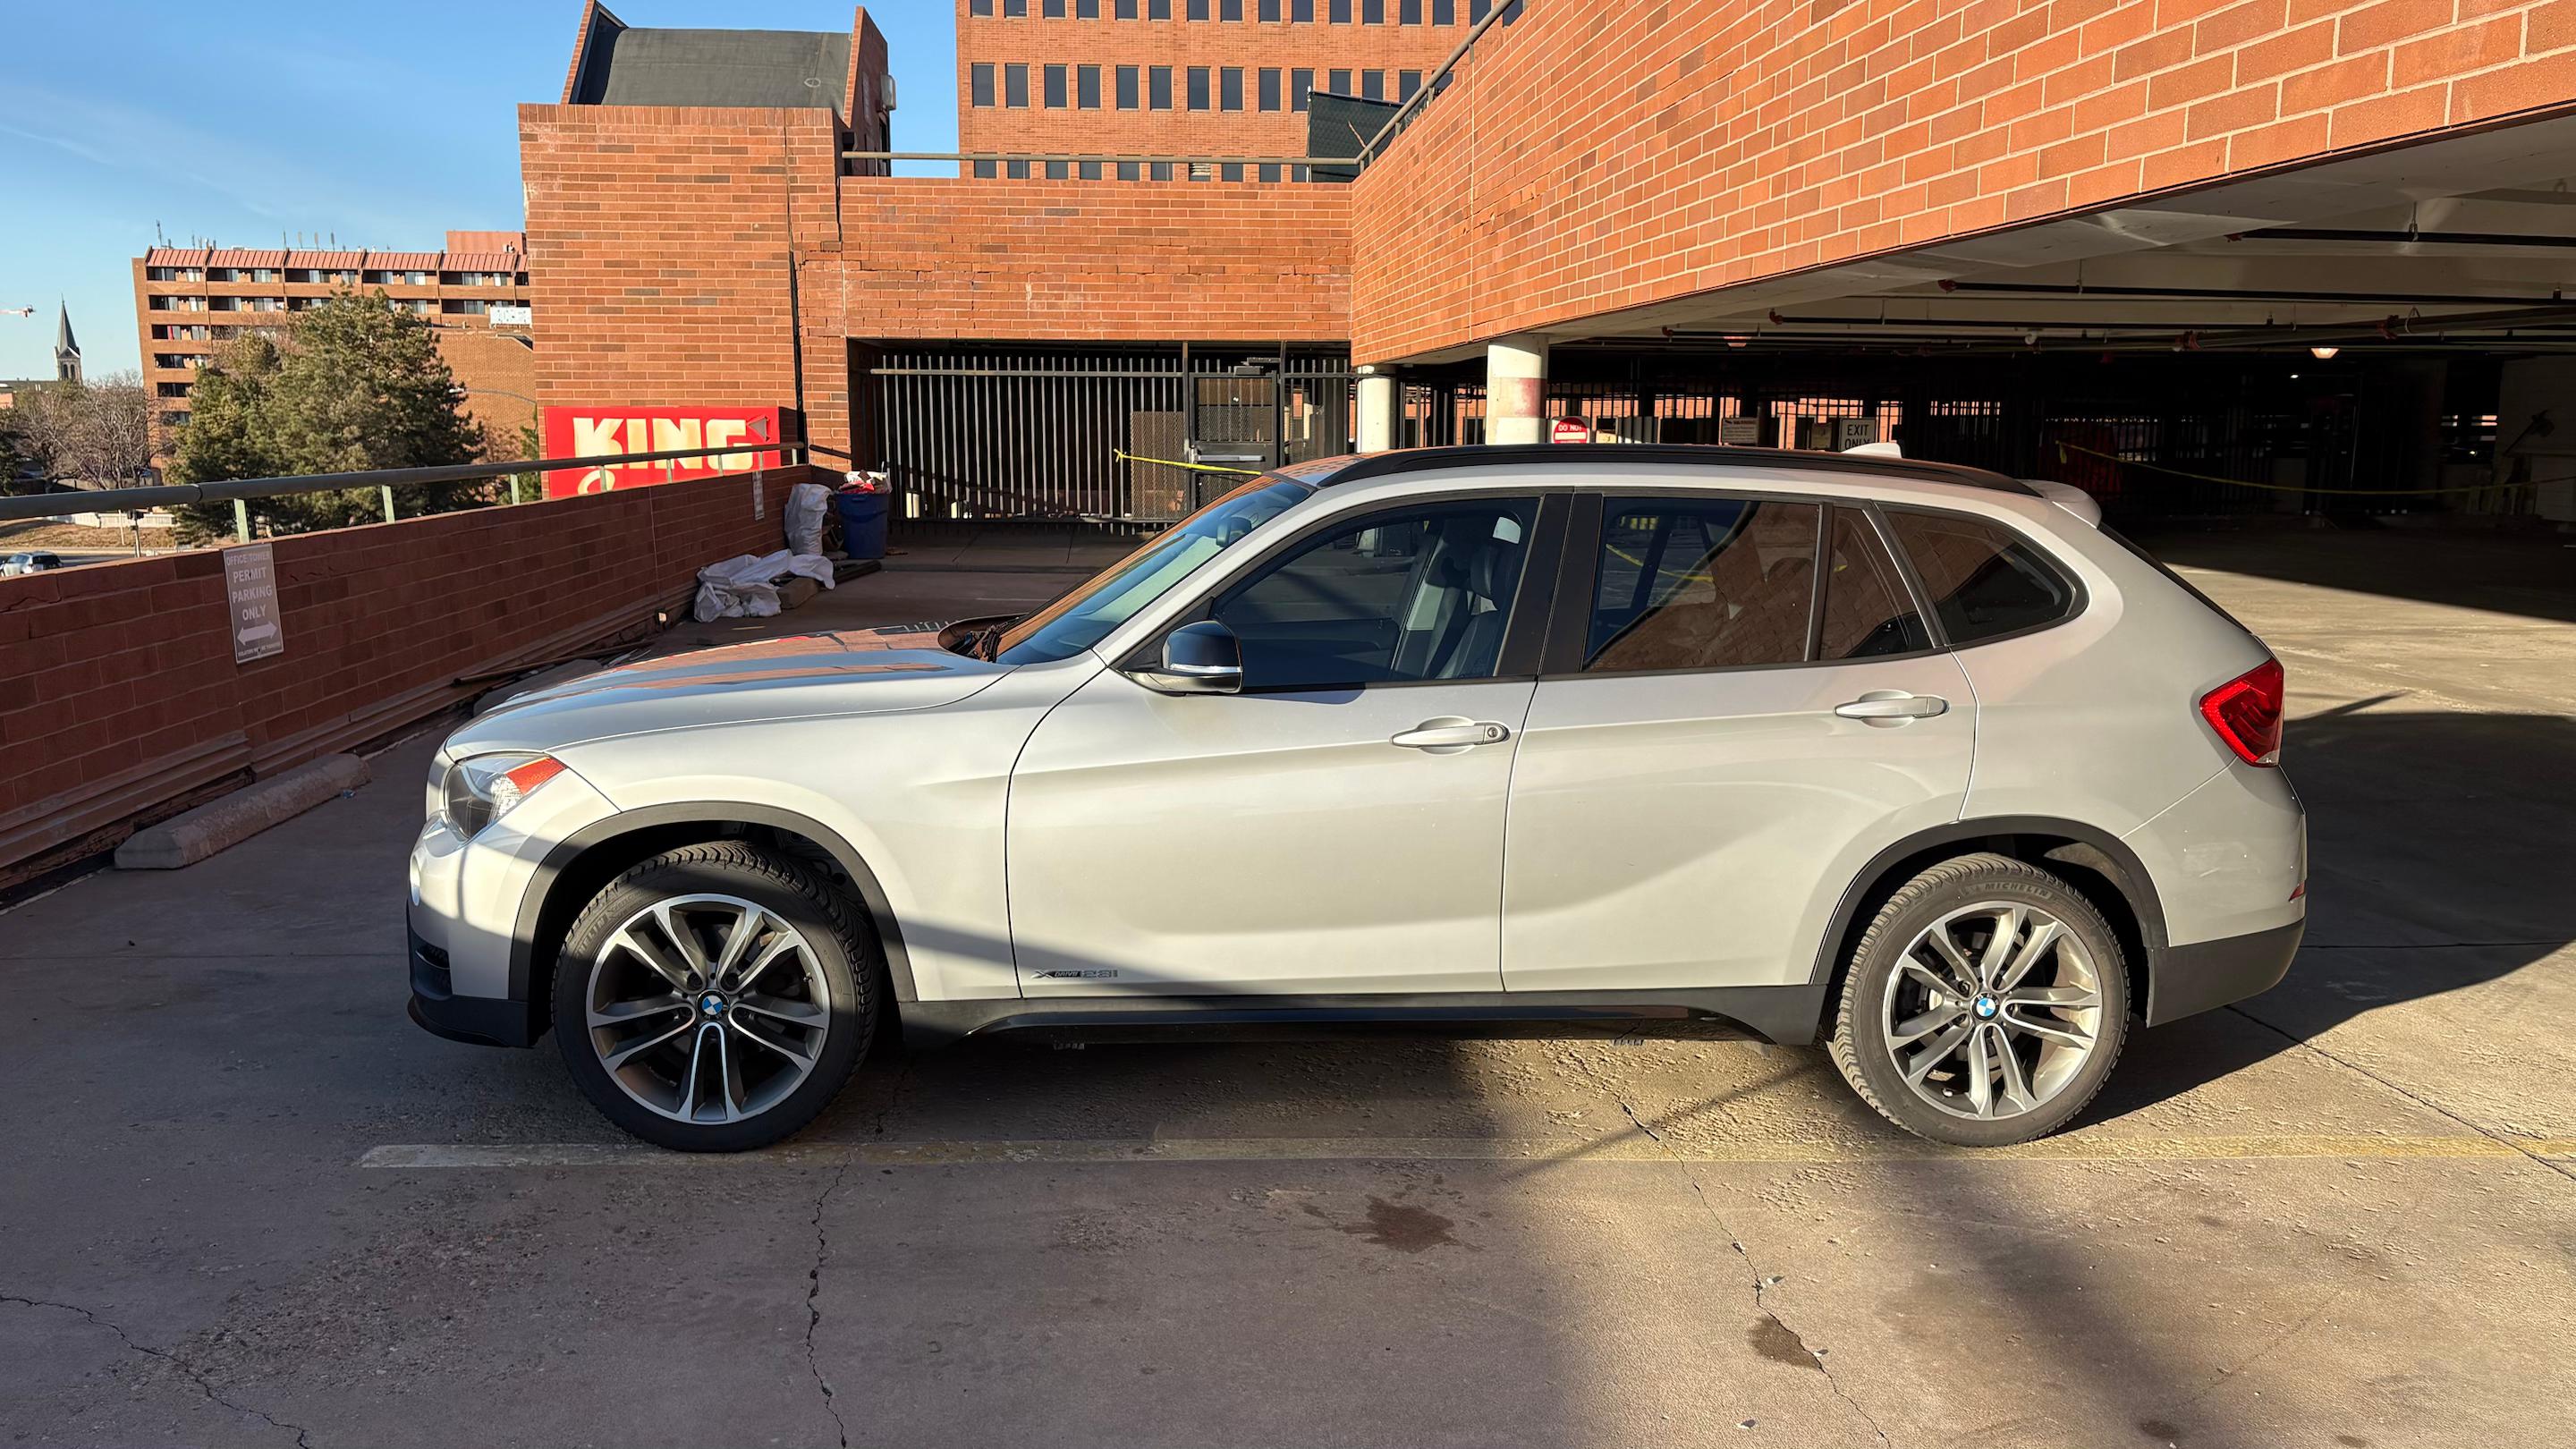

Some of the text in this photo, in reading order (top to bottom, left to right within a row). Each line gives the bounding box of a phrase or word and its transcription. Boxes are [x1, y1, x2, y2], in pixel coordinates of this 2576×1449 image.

[1557, 424, 1568, 432] DO
[1847, 424, 1869, 436] EXIT
[572, 417, 753, 470] KING
[226, 554, 248, 566] OFFICE
[233, 566, 267, 583] PERMIT
[233, 585, 273, 604] PARKING
[242, 604, 267, 621] ONLY
[1985, 882, 2049, 897] MICHELIN
